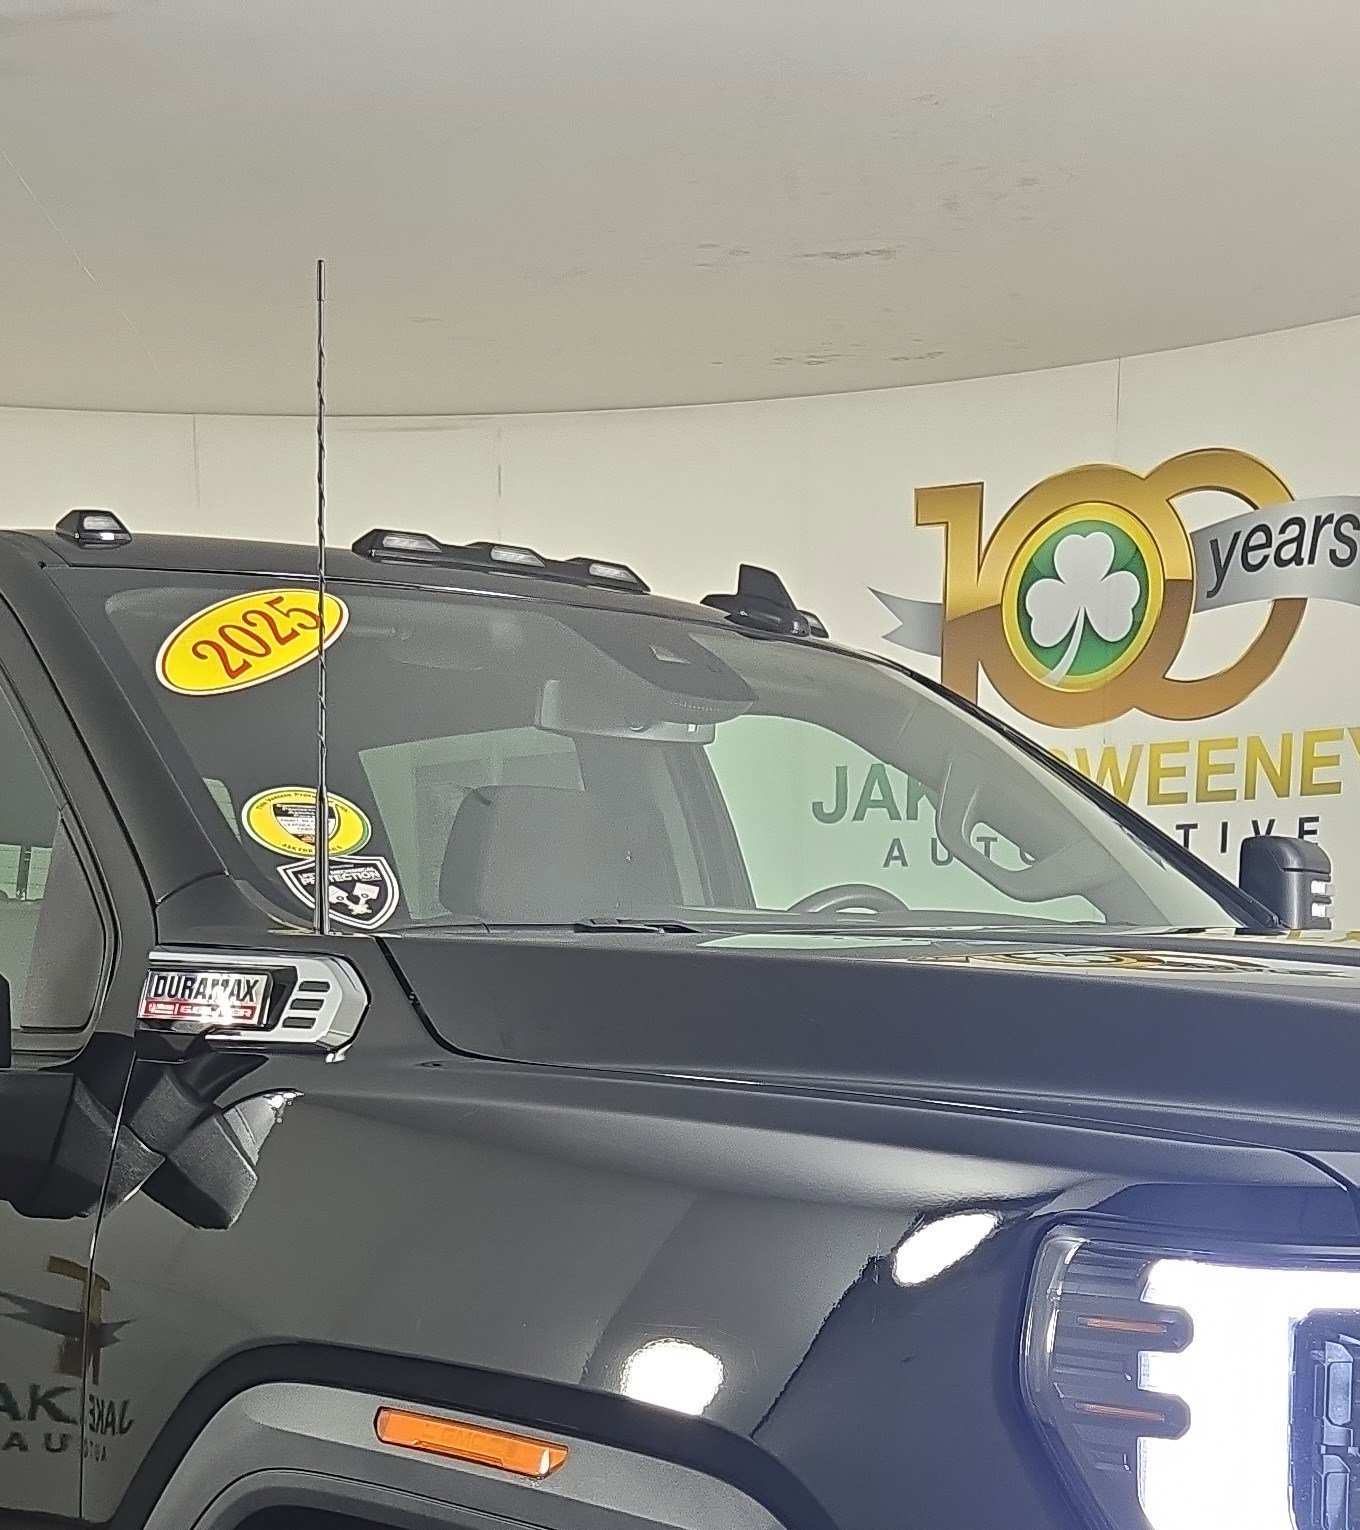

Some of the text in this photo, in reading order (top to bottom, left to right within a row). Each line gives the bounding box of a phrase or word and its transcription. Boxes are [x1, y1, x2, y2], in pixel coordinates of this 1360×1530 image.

[914, 448, 1360, 729] 100 years
[191, 595, 324, 681] 2025
[812, 763, 940, 824] JAK
